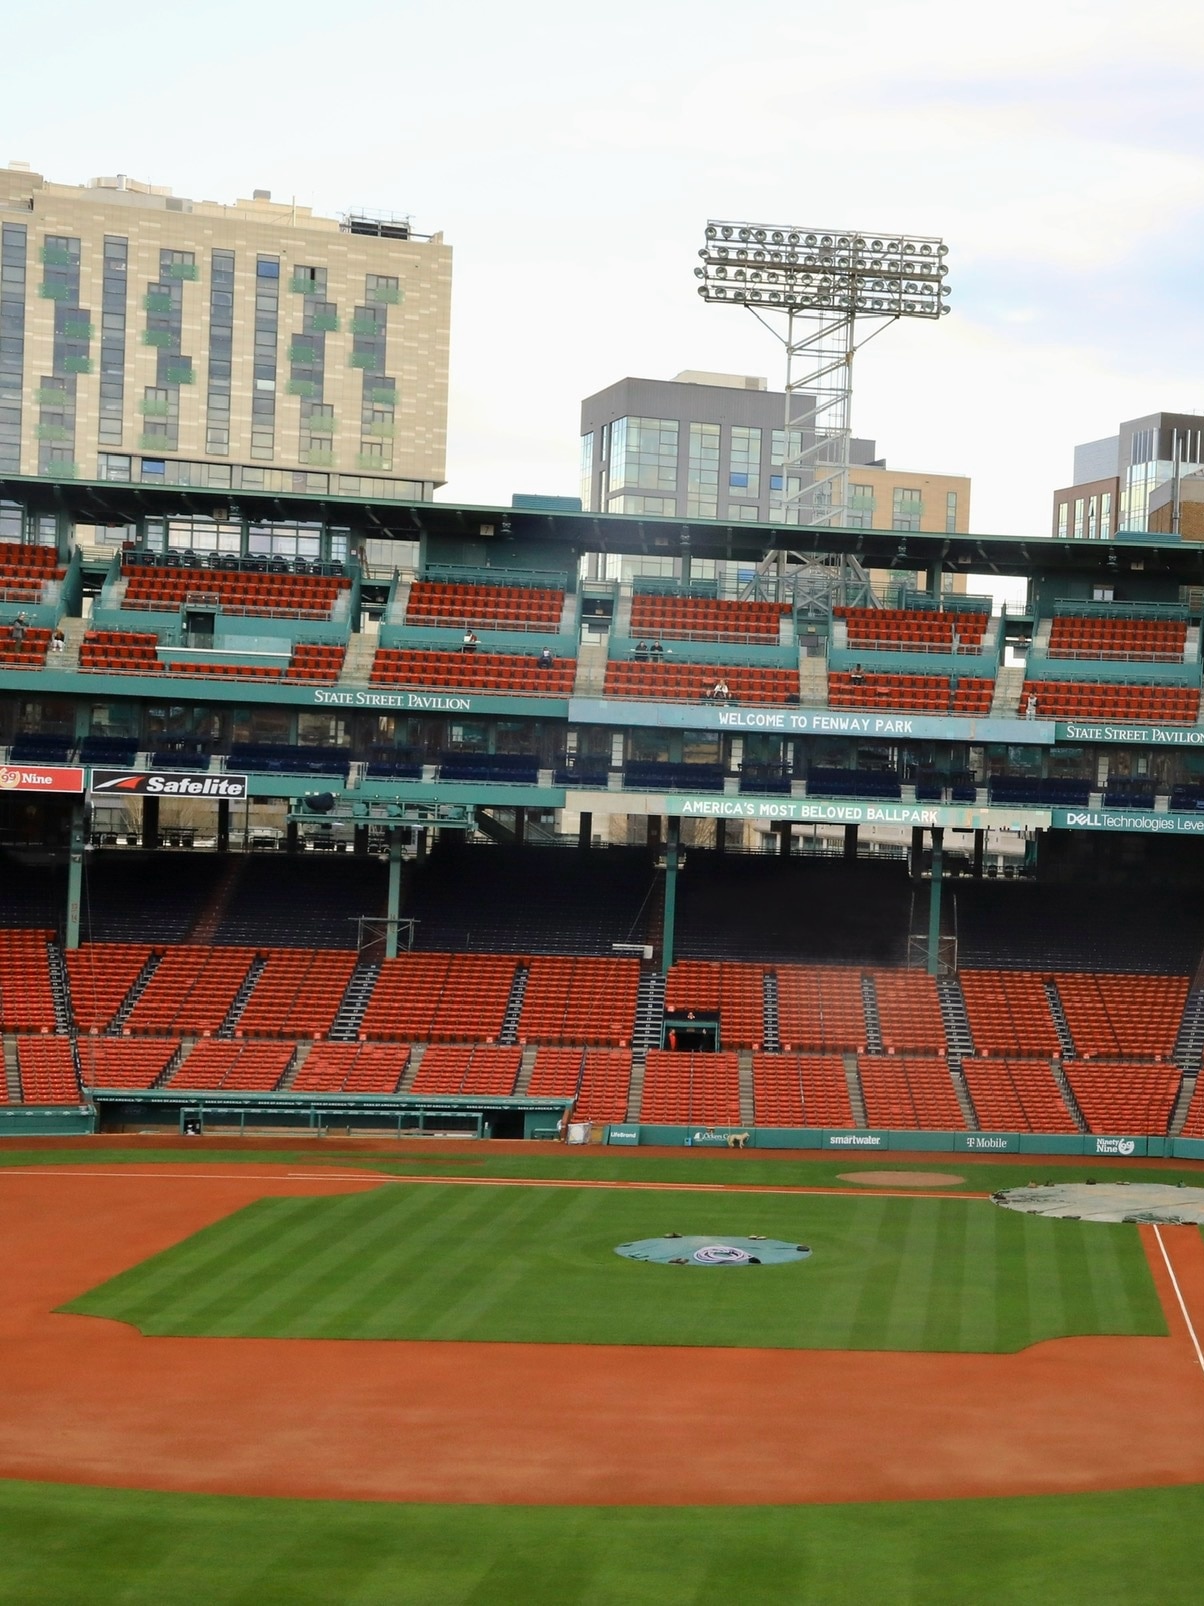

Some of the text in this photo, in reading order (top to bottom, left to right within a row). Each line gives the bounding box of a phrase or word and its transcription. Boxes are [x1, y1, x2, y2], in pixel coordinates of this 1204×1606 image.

[314, 690, 471, 710] STATE STREET PAVILION
[718, 712, 912, 732] WELCOME TO FENWAY PARK
[1066, 726, 1102, 739] STATE
[1104, 727, 1148, 741] STREET
[22, 773, 53, 784] Nine
[146, 776, 243, 795] Safelite
[682, 801, 938, 823] AMERICA'S MOST BELOVED BALLPARK
[1066, 813, 1101, 826] DELL
[1101, 814, 1174, 831] Technologies
[830, 1135, 880, 1145] smartwater
[976, 1138, 1007, 1147] Mobile
[1096, 1138, 1119, 1146] Ninety
